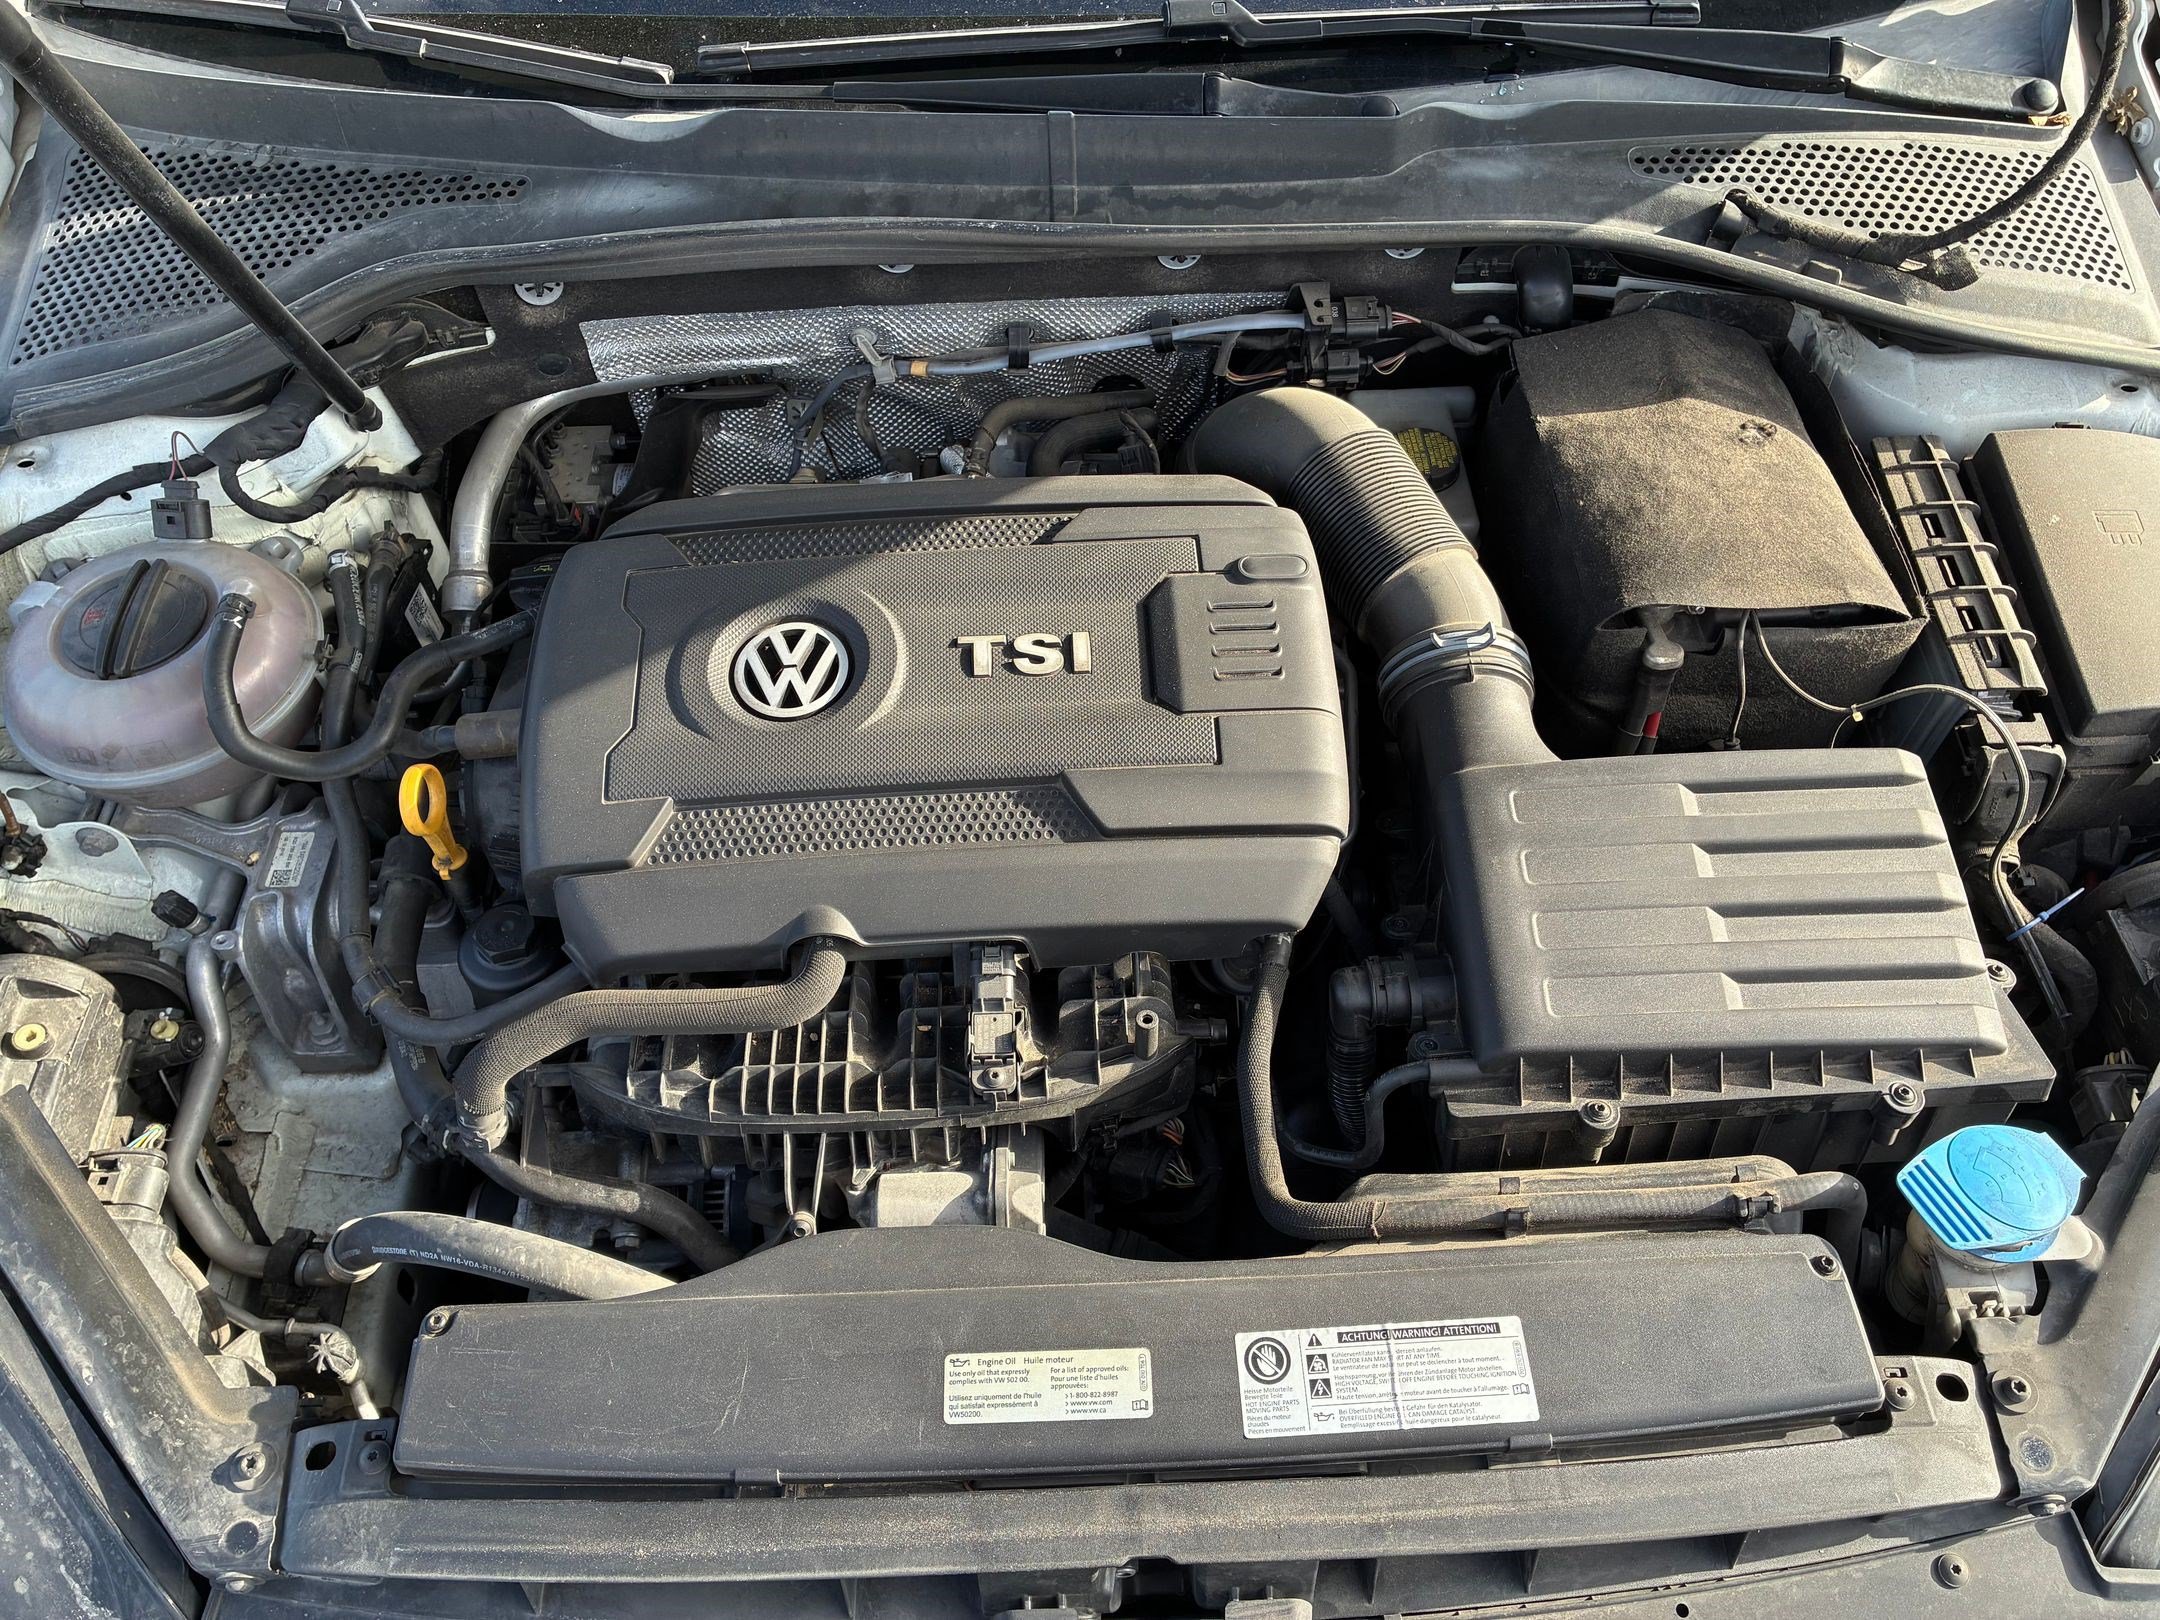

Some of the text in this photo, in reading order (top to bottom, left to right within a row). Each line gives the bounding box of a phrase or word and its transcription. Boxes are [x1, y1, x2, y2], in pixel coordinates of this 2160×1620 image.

[957, 630, 1093, 678] TSI
[420, 1251, 439, 1260] ND2A
[1340, 1324, 1496, 1341] ACHTUNG! WARNING! ATTENTION!
[977, 1358, 1003, 1367] Engine
[1001, 1368, 1029, 1376] expressly
[1085, 1365, 1115, 1374] approved
[949, 1378, 976, 1386] complies
[1050, 1382, 1088, 1390] approuvées:
[974, 1393, 1011, 1402] uniquement
[987, 1401, 1032, 1410] expressément
